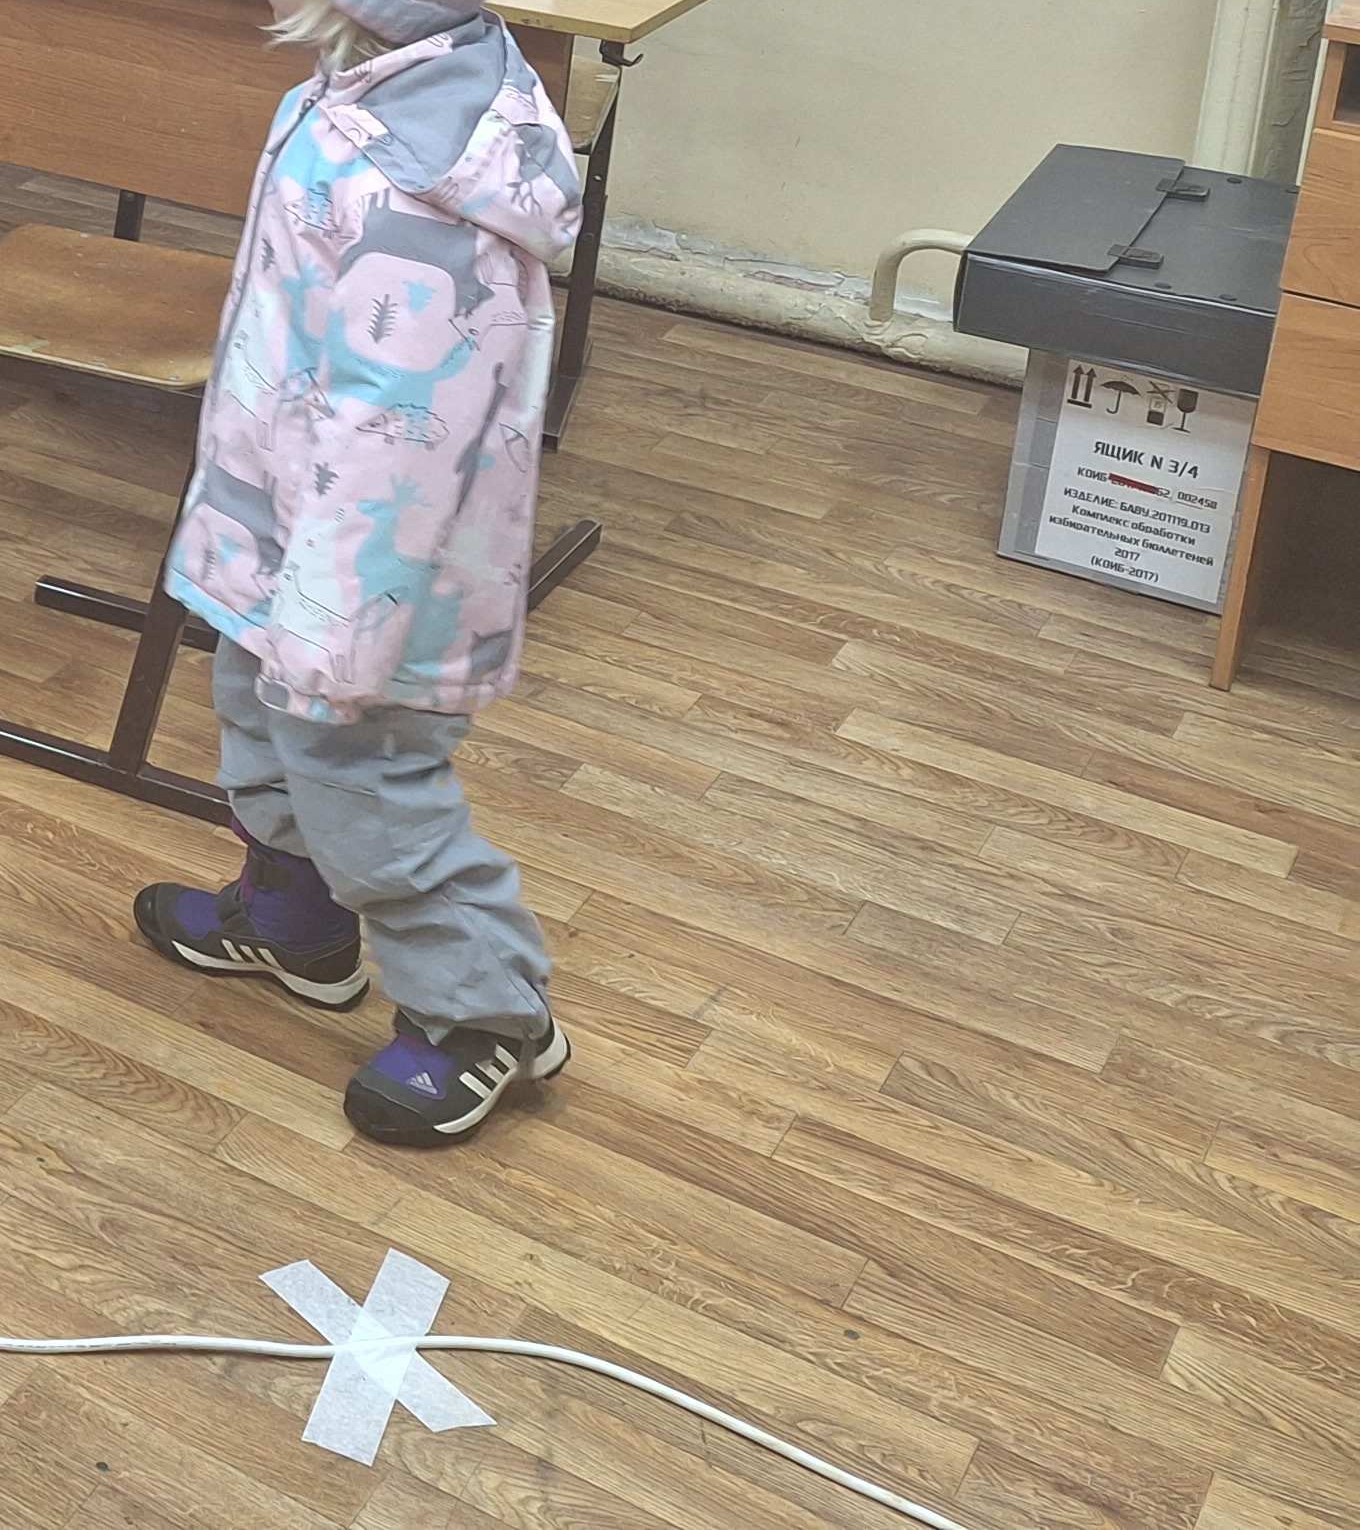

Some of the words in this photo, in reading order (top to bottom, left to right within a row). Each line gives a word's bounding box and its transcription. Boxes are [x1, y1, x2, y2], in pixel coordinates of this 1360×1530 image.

[1093, 441, 1146, 465] ЯЩИК
[1150, 455, 1164, 470] N
[1168, 459, 1199, 479] 3/4
[1063, 487, 1118, 508] ИЗДЕЛИЕ:
[1049, 515, 1140, 546] избирательных
[1142, 538, 1214, 567] бюллетеней
[1072, 504, 1129, 528] Комплекс
[1131, 522, 1196, 545] обработки
[1090, 555, 1159, 583] (КОИБ-2017)
[1114, 547, 1140, 561] 2017
